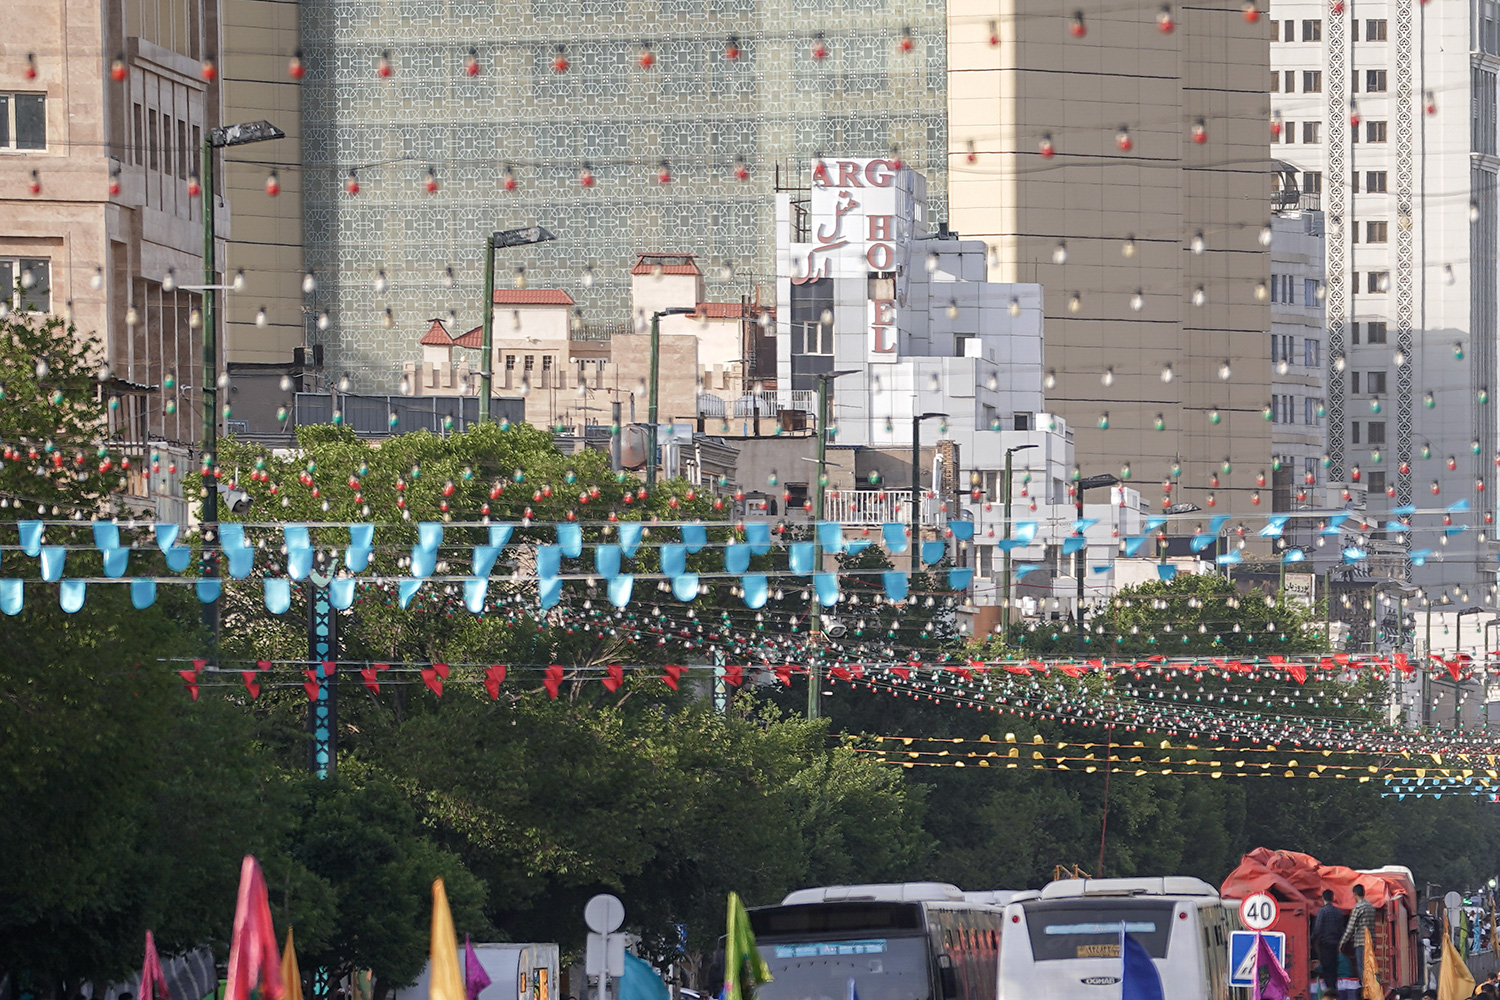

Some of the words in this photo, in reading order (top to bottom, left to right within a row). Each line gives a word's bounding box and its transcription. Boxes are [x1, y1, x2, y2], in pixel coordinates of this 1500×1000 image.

[813, 159, 894, 188] ARG
[817, 190, 859, 243] هتل
[1247, 901, 1272, 920] 40
